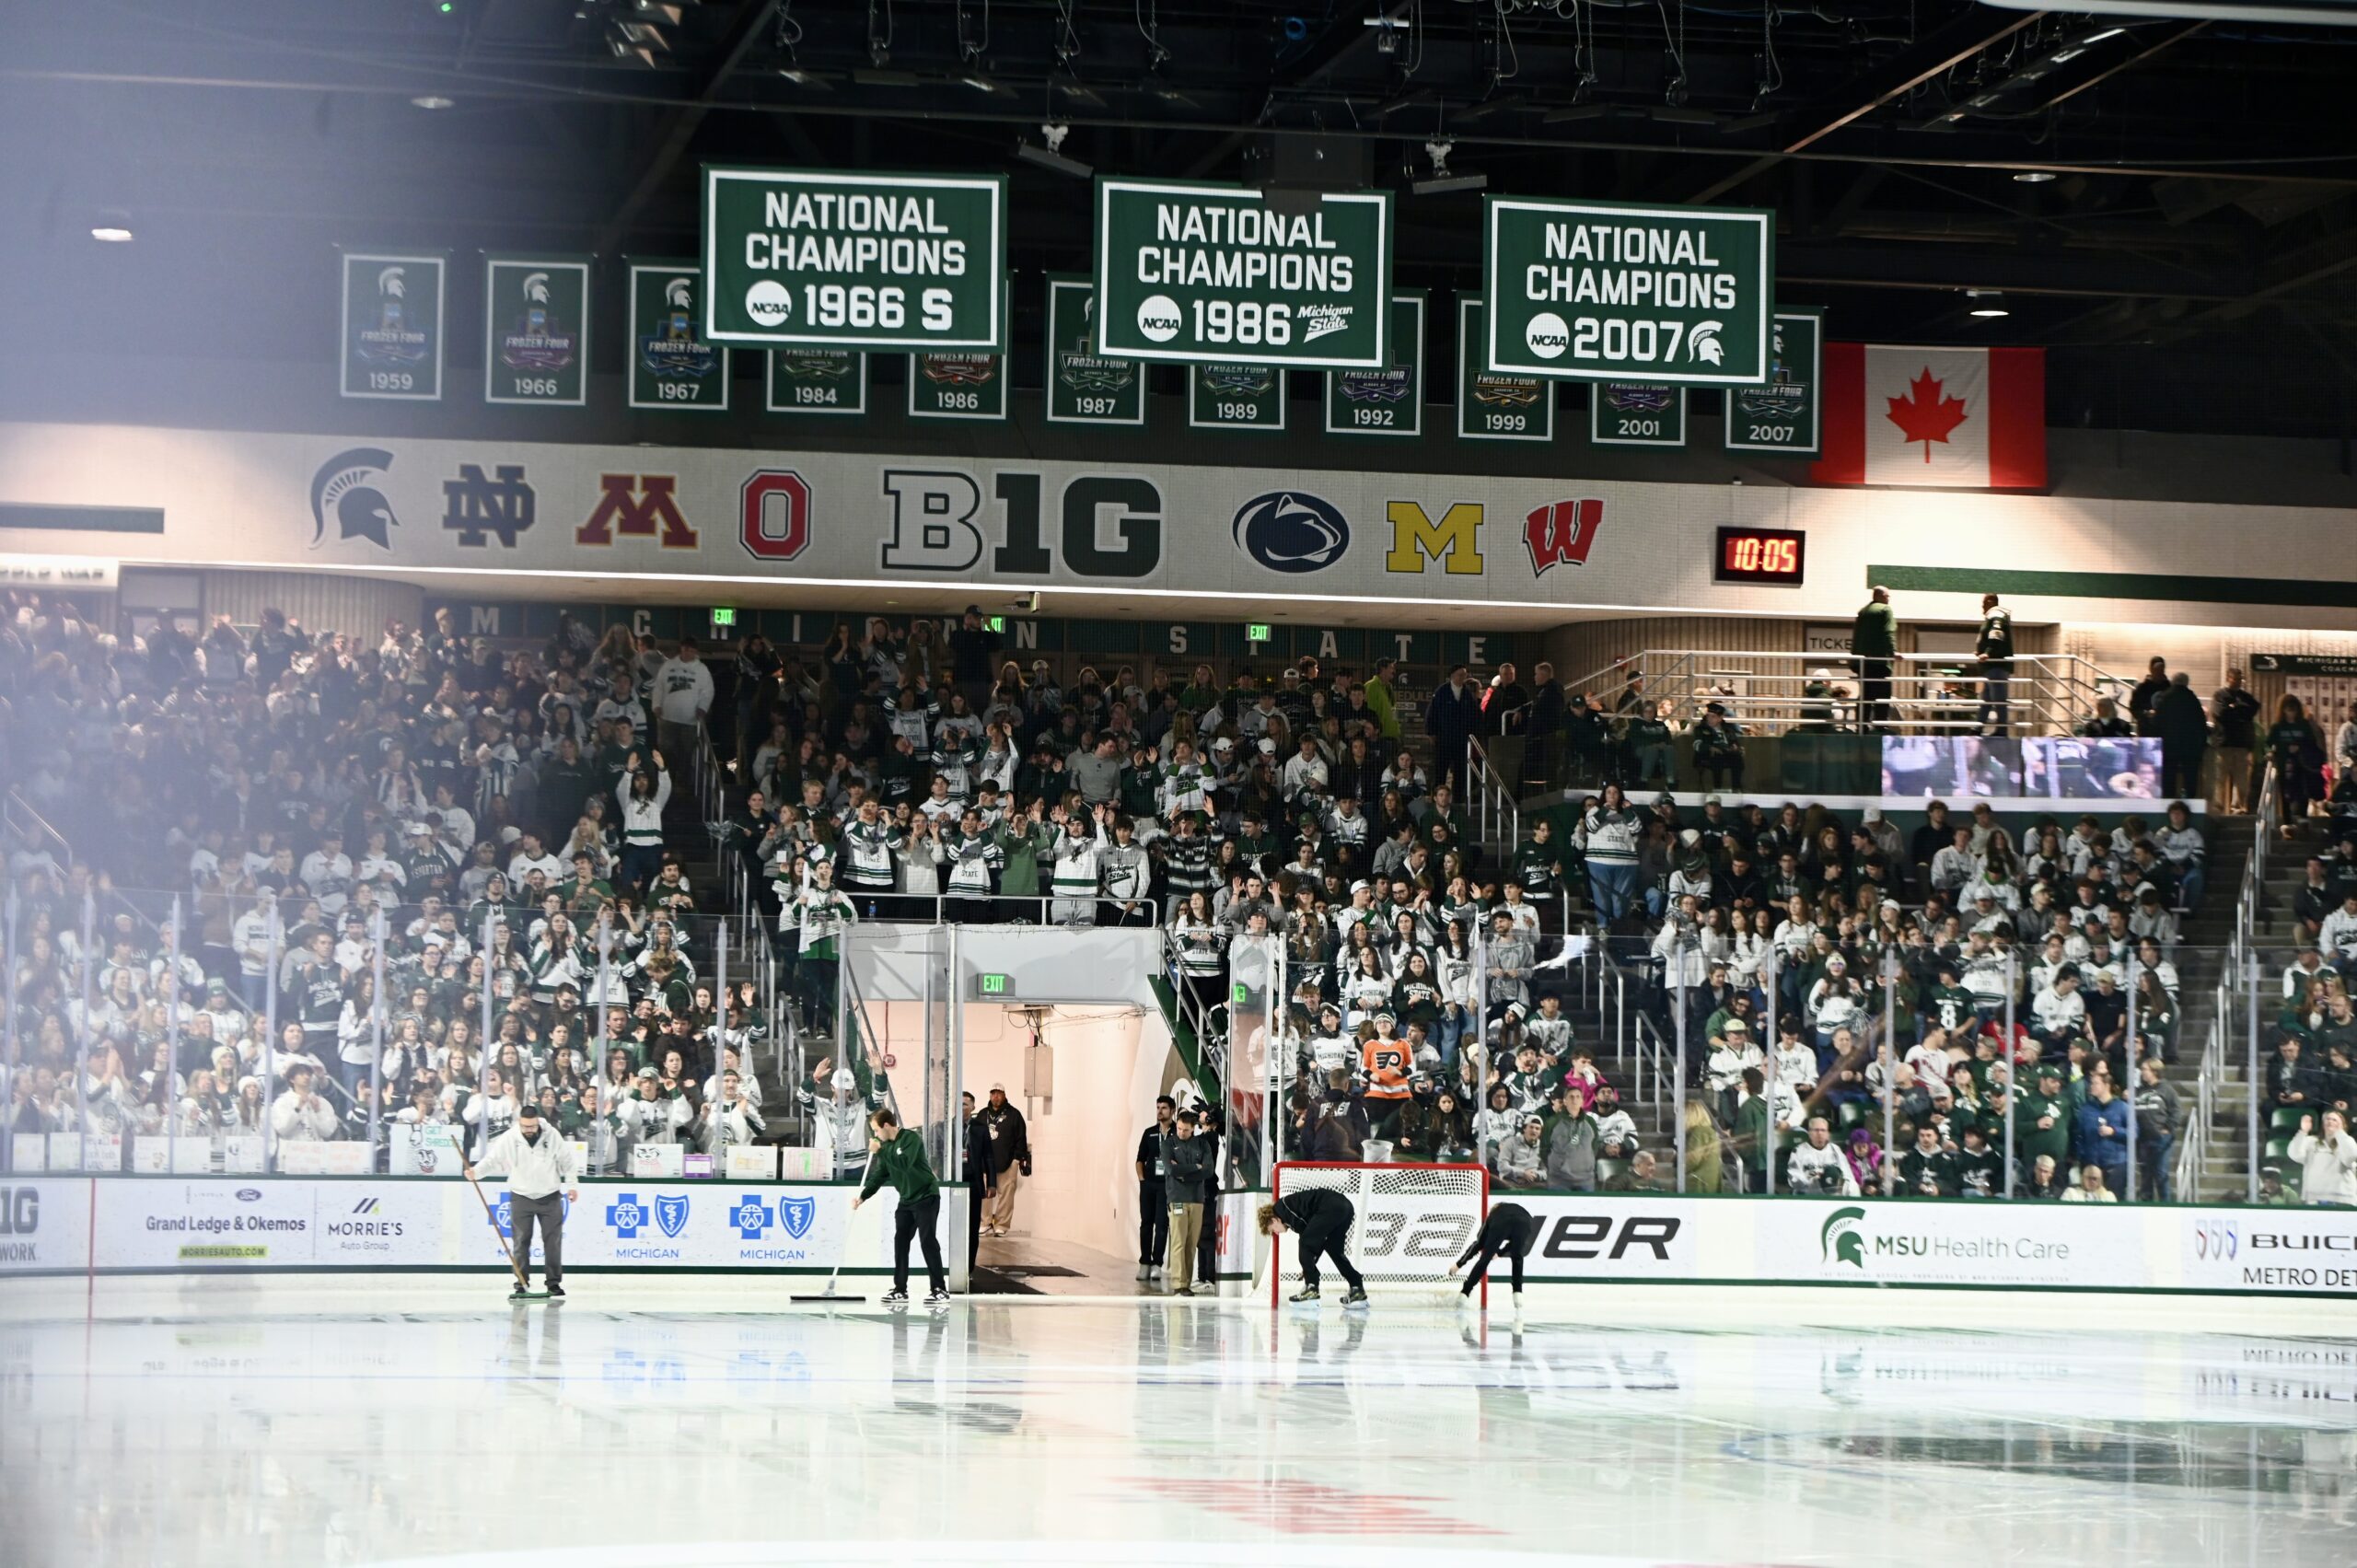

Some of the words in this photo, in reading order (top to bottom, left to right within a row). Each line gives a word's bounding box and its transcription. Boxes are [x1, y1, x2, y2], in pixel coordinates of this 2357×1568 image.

[765, 191, 949, 234] NATIONAL
[1157, 203, 1337, 249] NATIONAL
[1545, 222, 1720, 267] NATIONAL
[745, 233, 966, 277] CHAMPIONS
[1137, 246, 1353, 293] CHAMPIONS
[1526, 263, 1736, 310] CHAMPIONS
[751, 302, 790, 315] NCAA
[804, 284, 905, 329] 1966
[921, 287, 953, 331] S
[1297, 304, 1353, 319] Michigan
[1142, 317, 1180, 331] NCAA
[1192, 299, 1291, 346] 1986
[1308, 317, 1349, 331] State
[648, 341, 686, 353] FROZEN
[1530, 335, 1567, 348] NCAA
[1573, 317, 1684, 363] 2007
[369, 372, 413, 390] 1959
[514, 377, 558, 396] 1966
[656, 382, 701, 400] 1967
[795, 386, 838, 404] 1984
[937, 391, 979, 409] 1986
[1075, 397, 1116, 414] 1987
[1216, 402, 1258, 420] 1989
[1353, 409, 1394, 426] 1992
[1485, 414, 1526, 431] 1999
[1618, 419, 1660, 436] 2001
[1748, 424, 1794, 442] 2007
[1386, 499, 1484, 575] M
[1522, 499, 1604, 579] W
[1734, 537, 1798, 573] 10:05
[714, 609, 735, 625] EXIT
[1249, 625, 1268, 641] EXIT
[960, 869, 979, 877] STATE
[1106, 865, 1134, 874] Michigan
[1108, 871, 1132, 880] State
[1191, 947, 1209, 956] STATE
[983, 974, 1004, 993] EXIT
[1941, 1004, 1956, 1031] 8
[426, 1125, 443, 1135] GET
[145, 1215, 185, 1232] Grand
[189, 1215, 231, 1234] Ledge
[234, 1216, 244, 1231] &
[248, 1215, 307, 1232] Okemos
[328, 1222, 403, 1236] MORRIE'S
[180, 1246, 266, 1258] MORRIESAUTO.COM
[340, 1241, 361, 1250] Auto
[363, 1241, 390, 1252] Group
[616, 1249, 679, 1259] MICHIGAN
[739, 1249, 805, 1260] MICHIGAN
[1875, 1236, 1928, 1257] MSU
[1934, 1236, 2010, 1259] Health
[2015, 1237, 2070, 1260] Care
[2243, 1267, 2317, 1286] METRO
